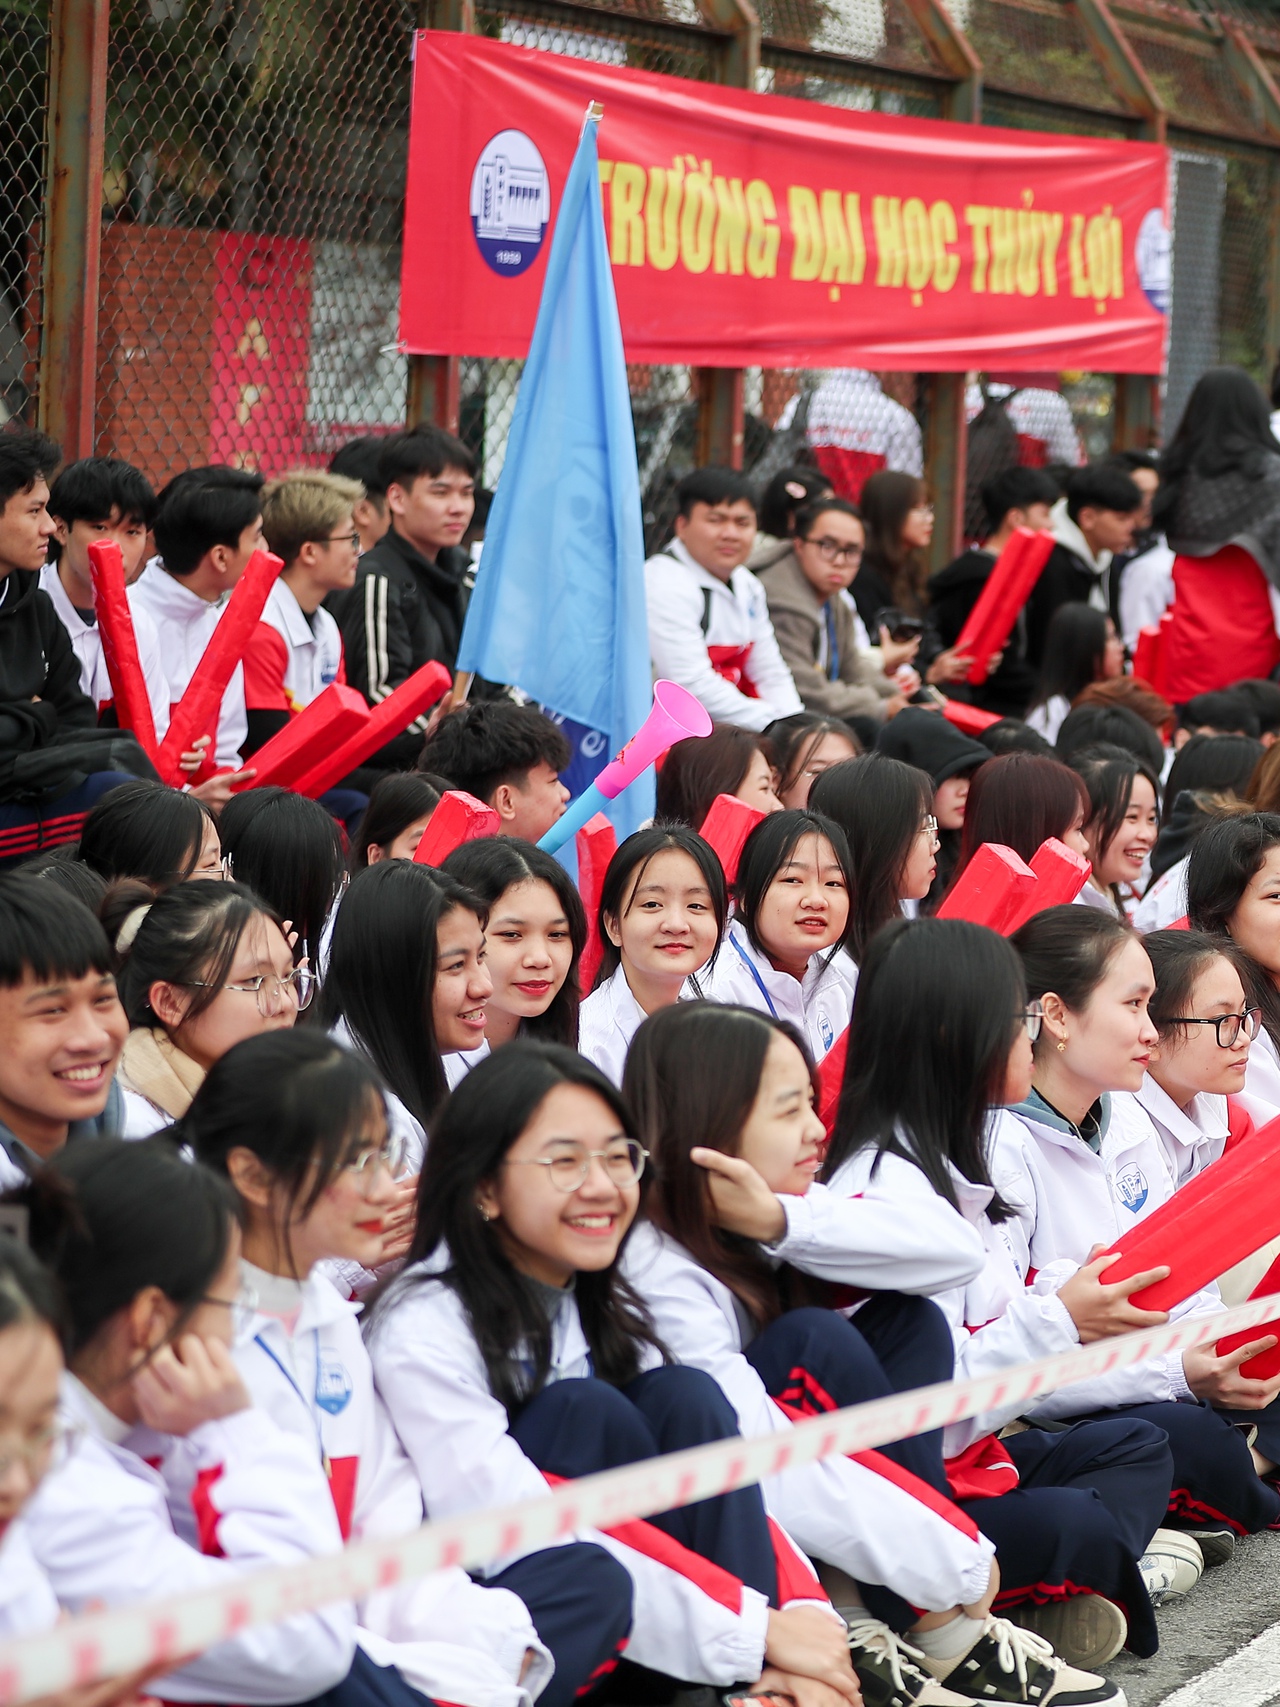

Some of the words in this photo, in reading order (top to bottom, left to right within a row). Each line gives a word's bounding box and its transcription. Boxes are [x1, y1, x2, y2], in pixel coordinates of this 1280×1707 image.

[788, 184, 866, 303] ĐẠI
[872, 195, 961, 308] HỌC
[964, 188, 1064, 297] THỦY
[1068, 203, 1125, 316] LỢI
